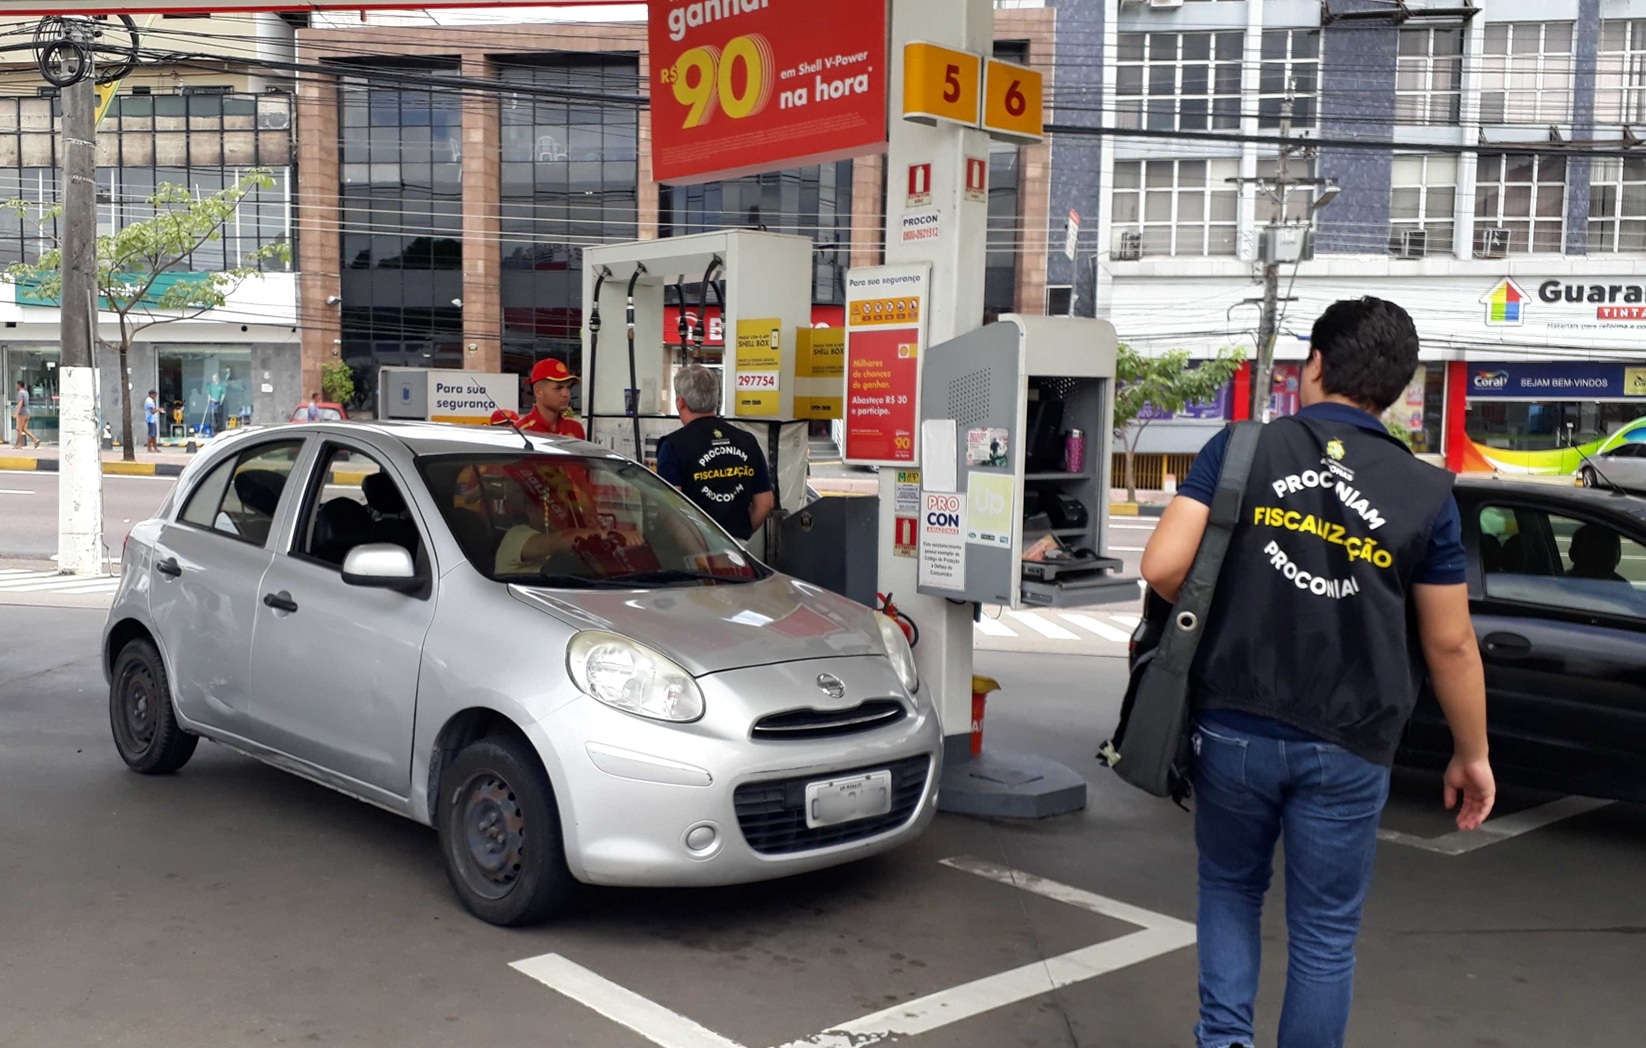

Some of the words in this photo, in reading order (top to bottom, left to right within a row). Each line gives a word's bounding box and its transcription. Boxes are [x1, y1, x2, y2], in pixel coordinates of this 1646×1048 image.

[780, 68, 796, 80] em
[798, 58, 822, 76] Shell
[825, 49, 868, 71] V-Power
[671, 32, 775, 130] 90
[942, 64, 961, 104] 5
[779, 87, 808, 109] na
[1004, 79, 1026, 117] 6
[903, 214, 938, 227] PROCON
[849, 279, 866, 287] Para
[882, 275, 921, 285] segurança
[756, 339, 770, 347] BOX
[738, 375, 775, 386] 297754
[1473, 375, 1504, 387] Coral
[1520, 377, 1550, 388] SEJAM
[436, 383, 463, 394] Para
[467, 386, 486, 394] sua
[436, 399, 496, 412] segurança
[886, 395, 896, 405] R$
[897, 395, 908, 404] 30
[927, 495, 960, 512] PRO
[927, 512, 959, 528] CON
